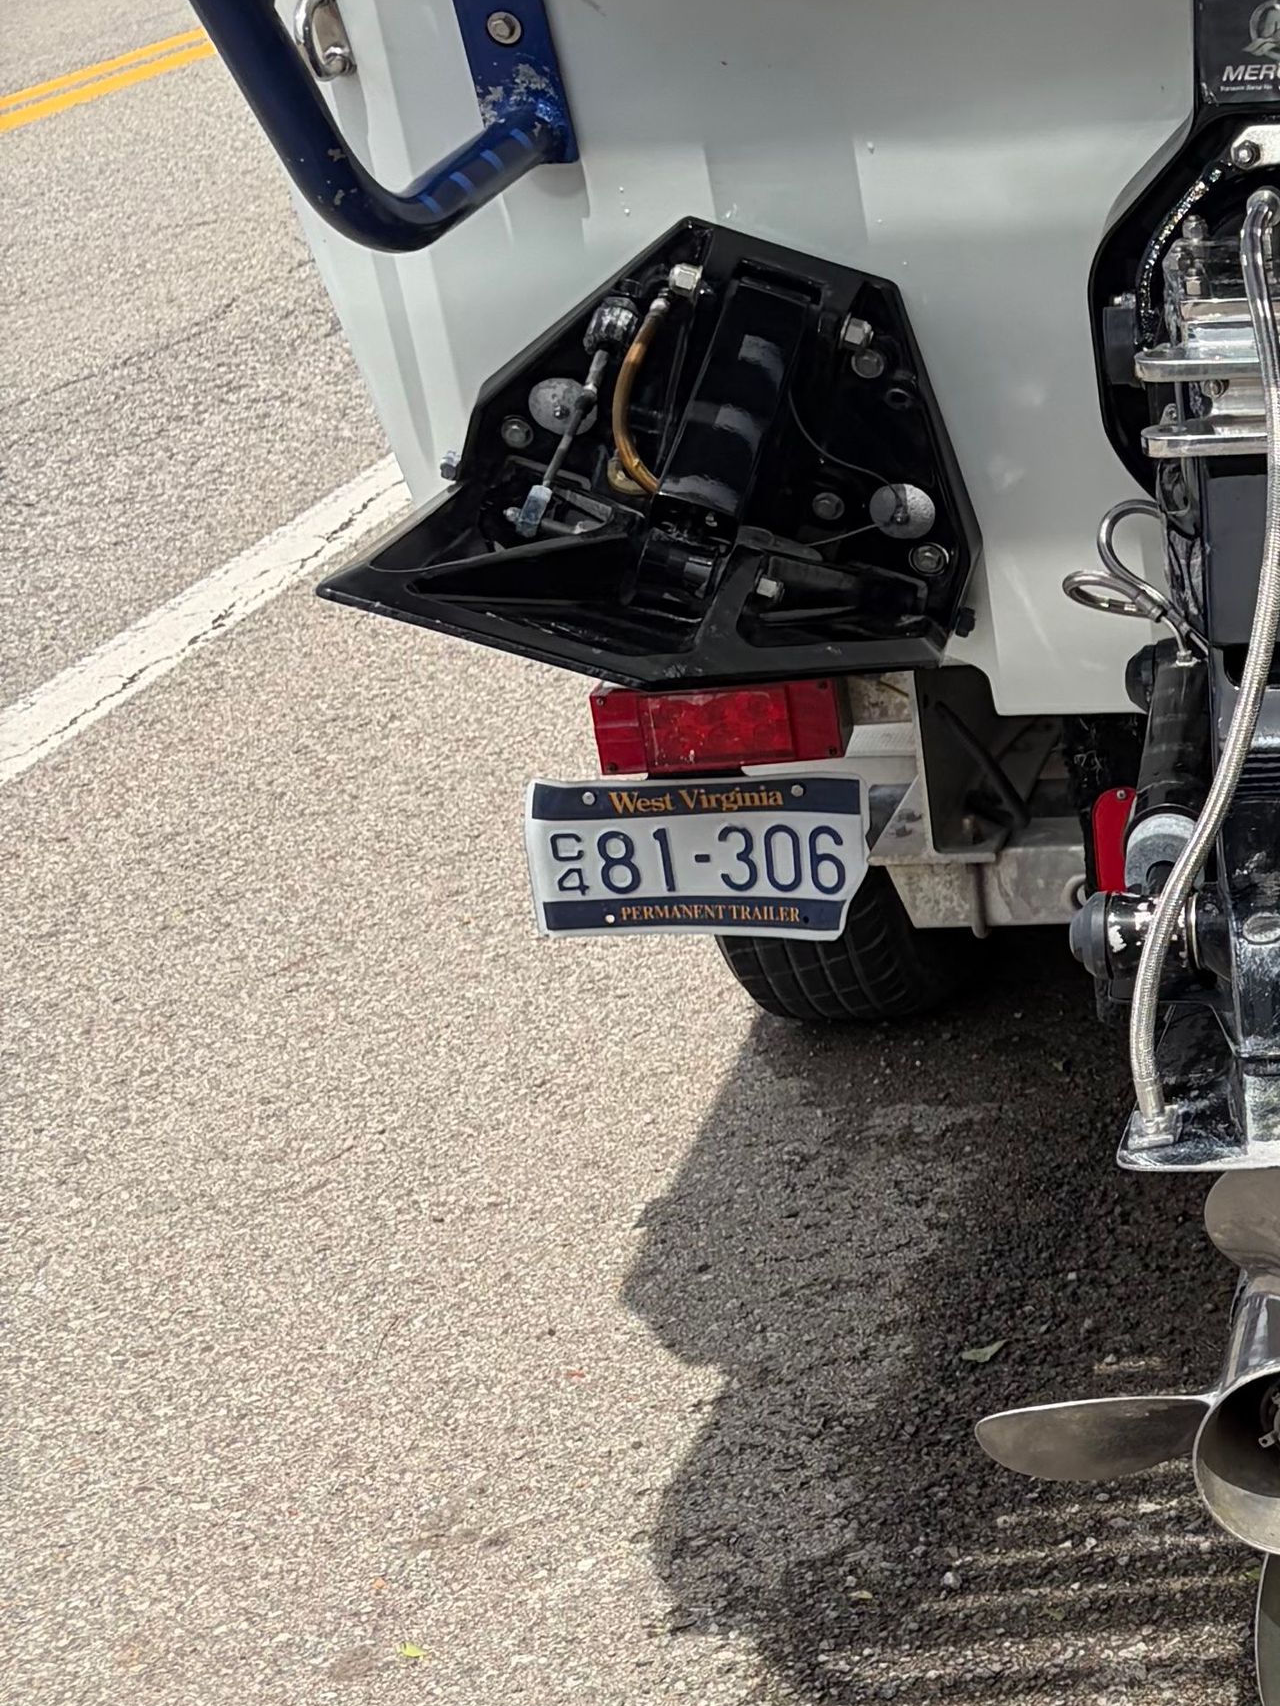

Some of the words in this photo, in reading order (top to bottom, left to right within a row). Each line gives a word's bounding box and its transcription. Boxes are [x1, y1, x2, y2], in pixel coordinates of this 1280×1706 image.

[608, 790, 676, 814] West
[678, 785, 784, 812] Virginia
[596, 823, 846, 895] 81-306
[620, 904, 726, 921] PERMANENT
[728, 904, 801, 922] TRAILER
